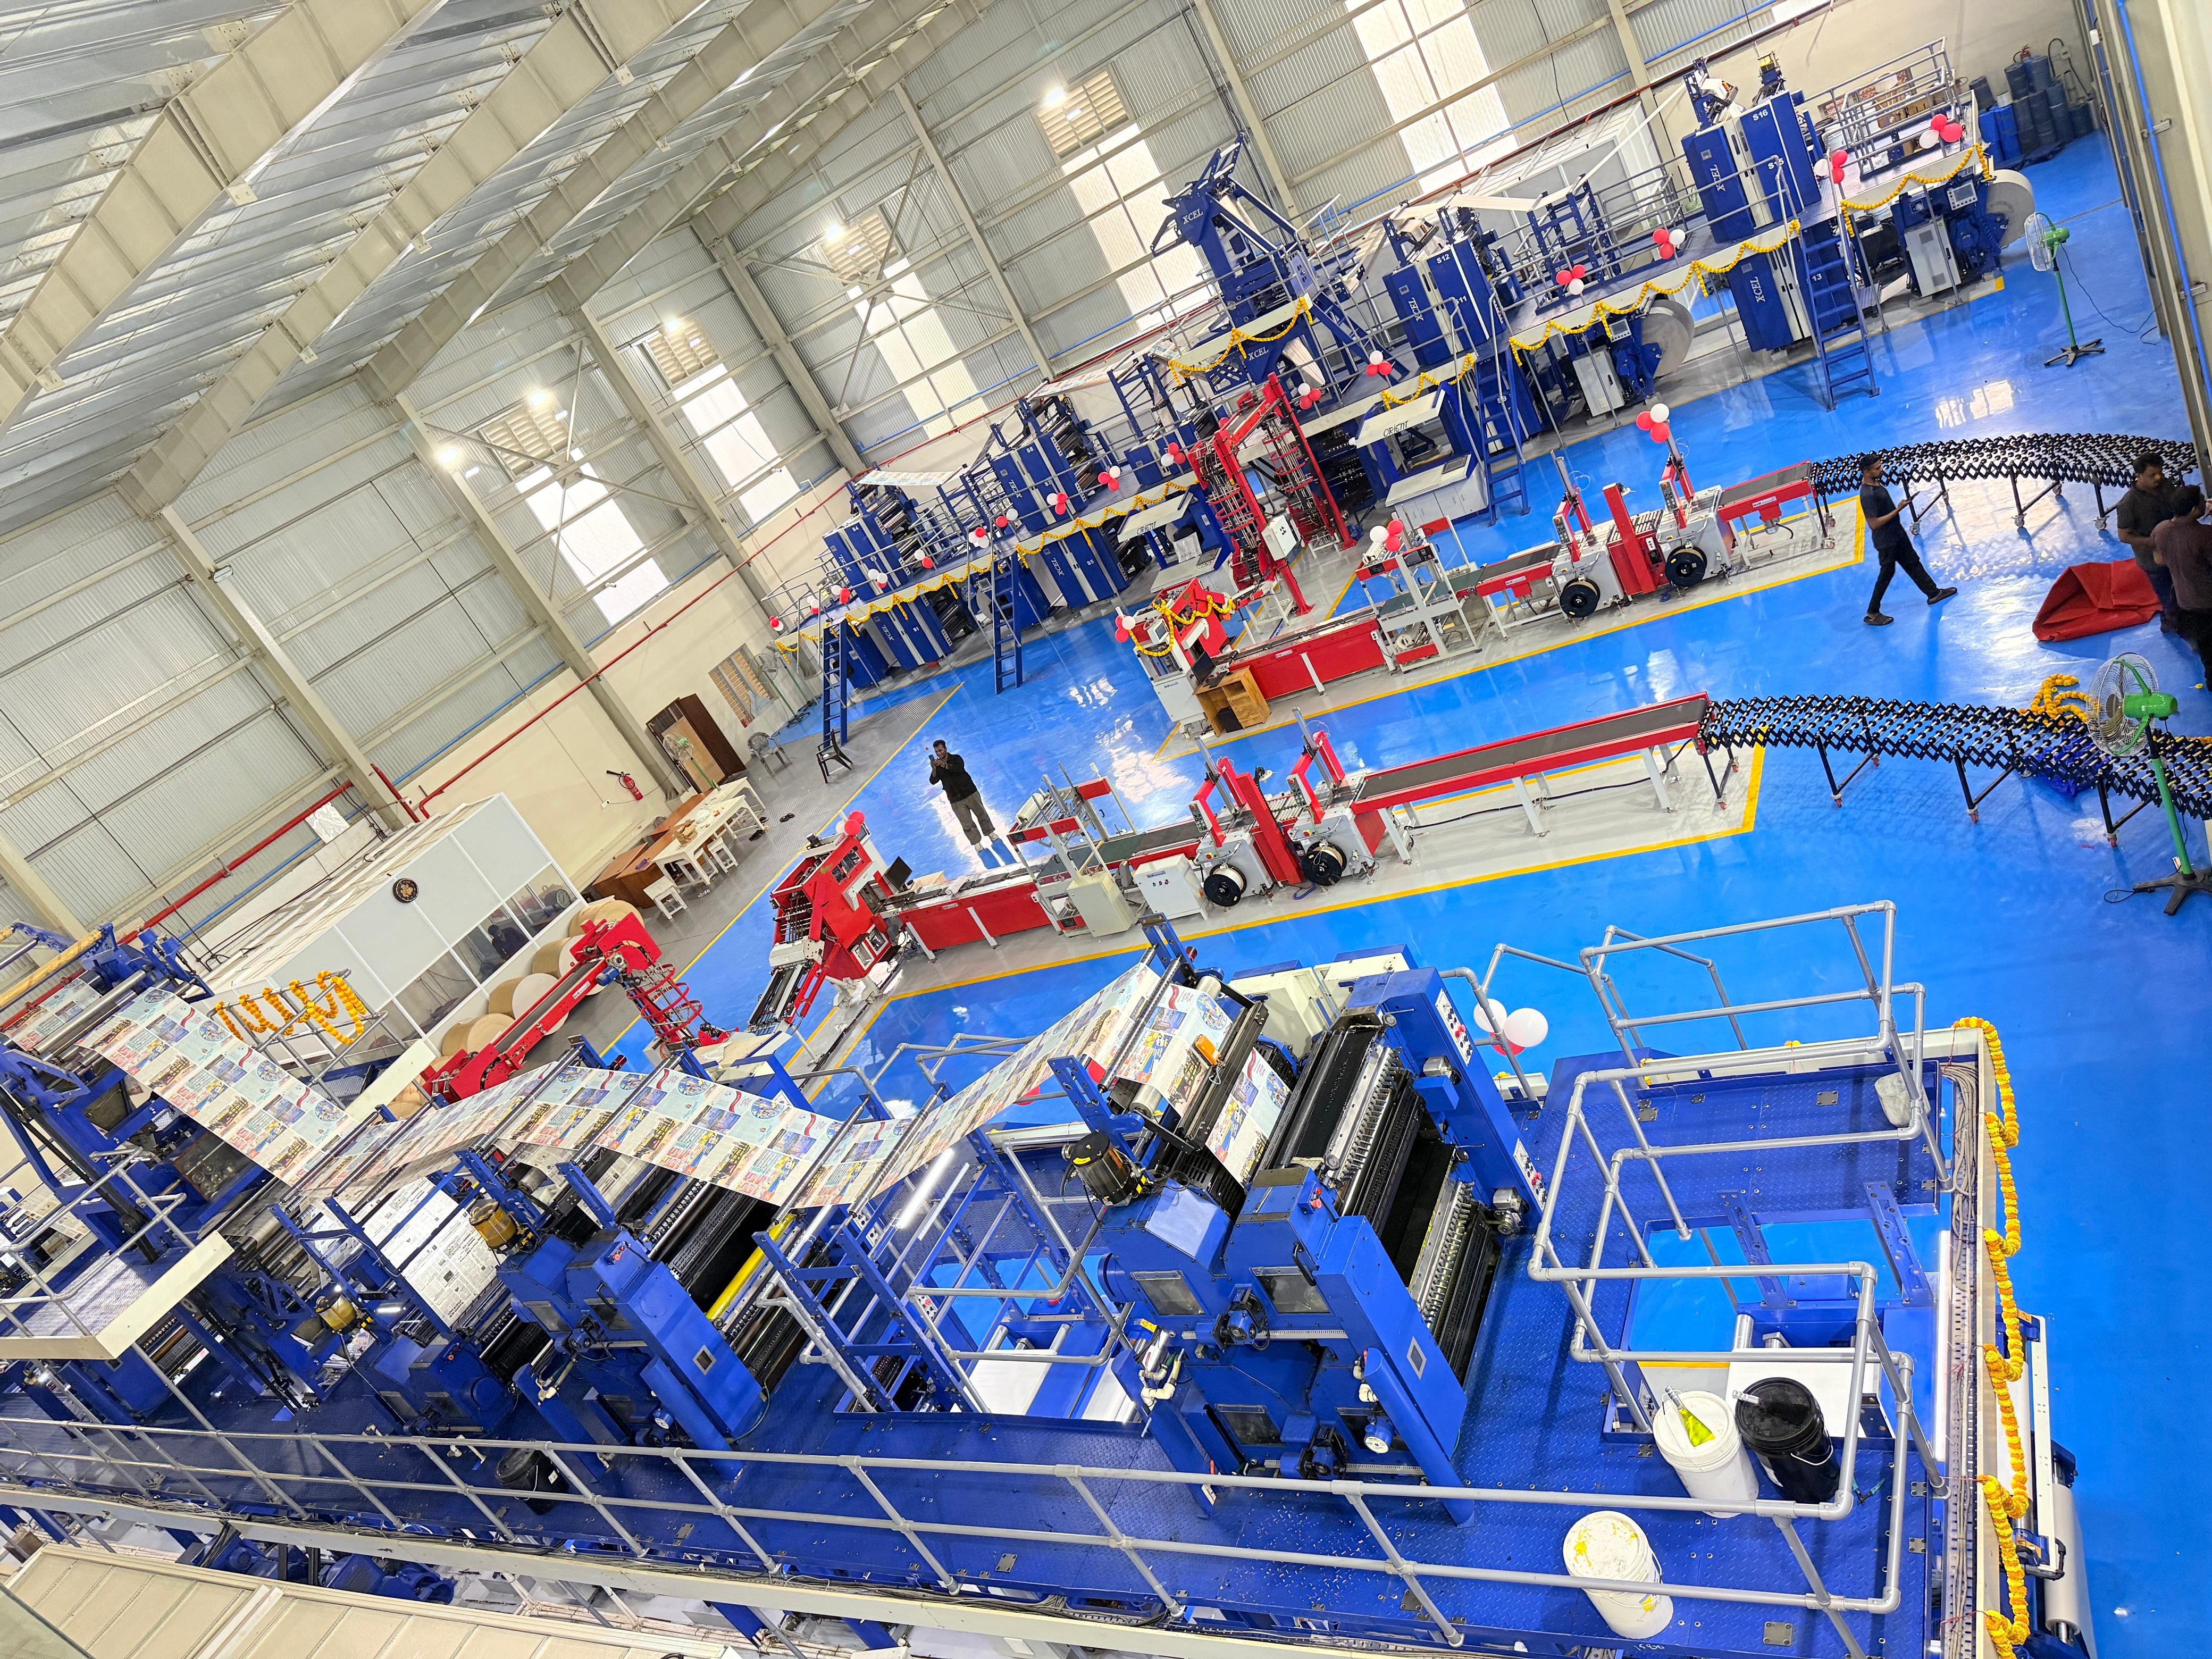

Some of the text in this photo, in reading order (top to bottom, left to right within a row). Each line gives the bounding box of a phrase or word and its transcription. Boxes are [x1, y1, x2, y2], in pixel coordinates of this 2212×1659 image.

[1752, 109, 1769, 121] S16
[1436, 253, 1450, 264] S12
[1383, 420, 1409, 437] ORIENT
[1137, 521, 1157, 535] ORIENT
